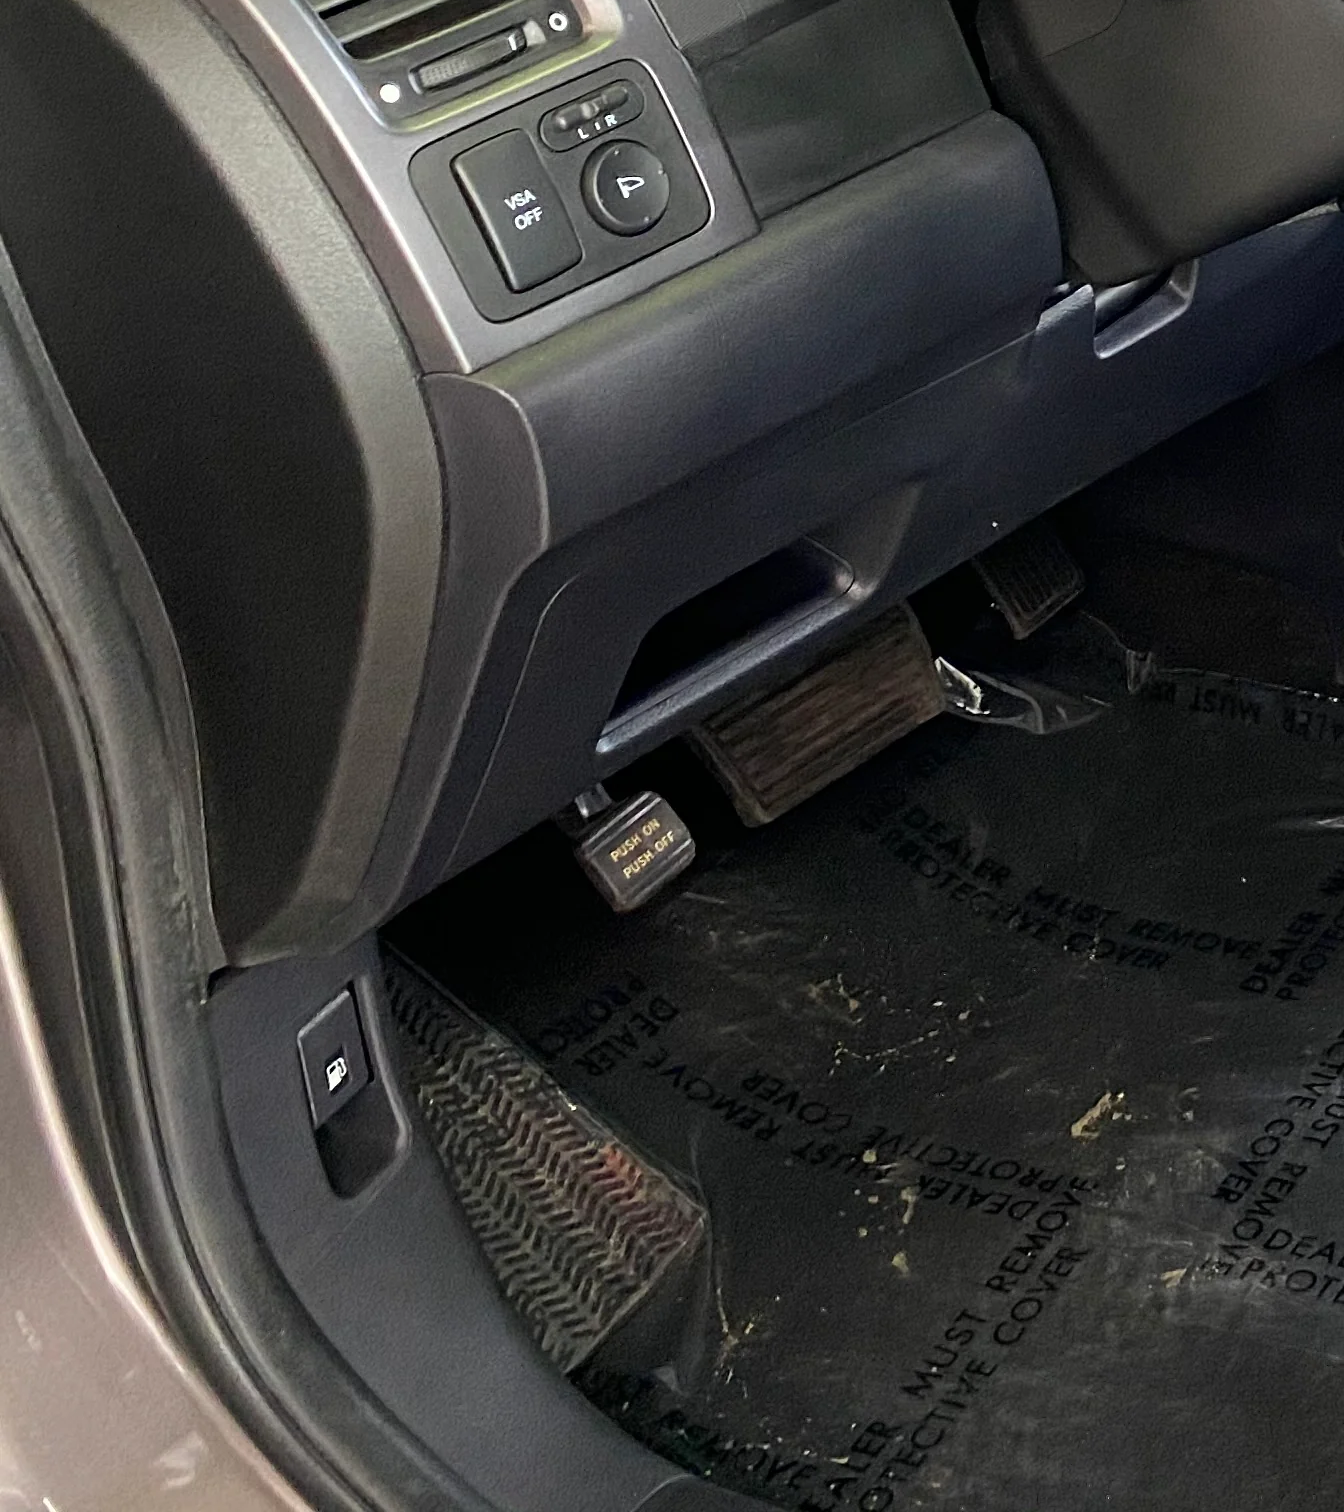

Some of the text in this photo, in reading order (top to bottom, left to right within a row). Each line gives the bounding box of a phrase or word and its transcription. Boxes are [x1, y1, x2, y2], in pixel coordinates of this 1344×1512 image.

[577, 114, 617, 139] L R
[504, 189, 536, 211] VSA
[514, 206, 543, 230] OFF
[610, 818, 661, 863] PUSH ON
[622, 830, 675, 880] PUSH OFF
[1127, 918, 1264, 963] REMOVE
[1239, 909, 1326, 994] DEALER
[642, 1046, 783, 1141] REMOVE
[741, 1068, 1062, 1192] PROTECTIVE COVER
[1210, 1119, 1295, 1206] COVER
[917, 1174, 1039, 1222] DEALER
[1202, 1161, 1308, 1277] REMOVE
[900, 1308, 986, 1401] MUST
[985, 1174, 1100, 1293] REMOVE
[858, 1246, 1090, 1511] OTECTIVE COVER
